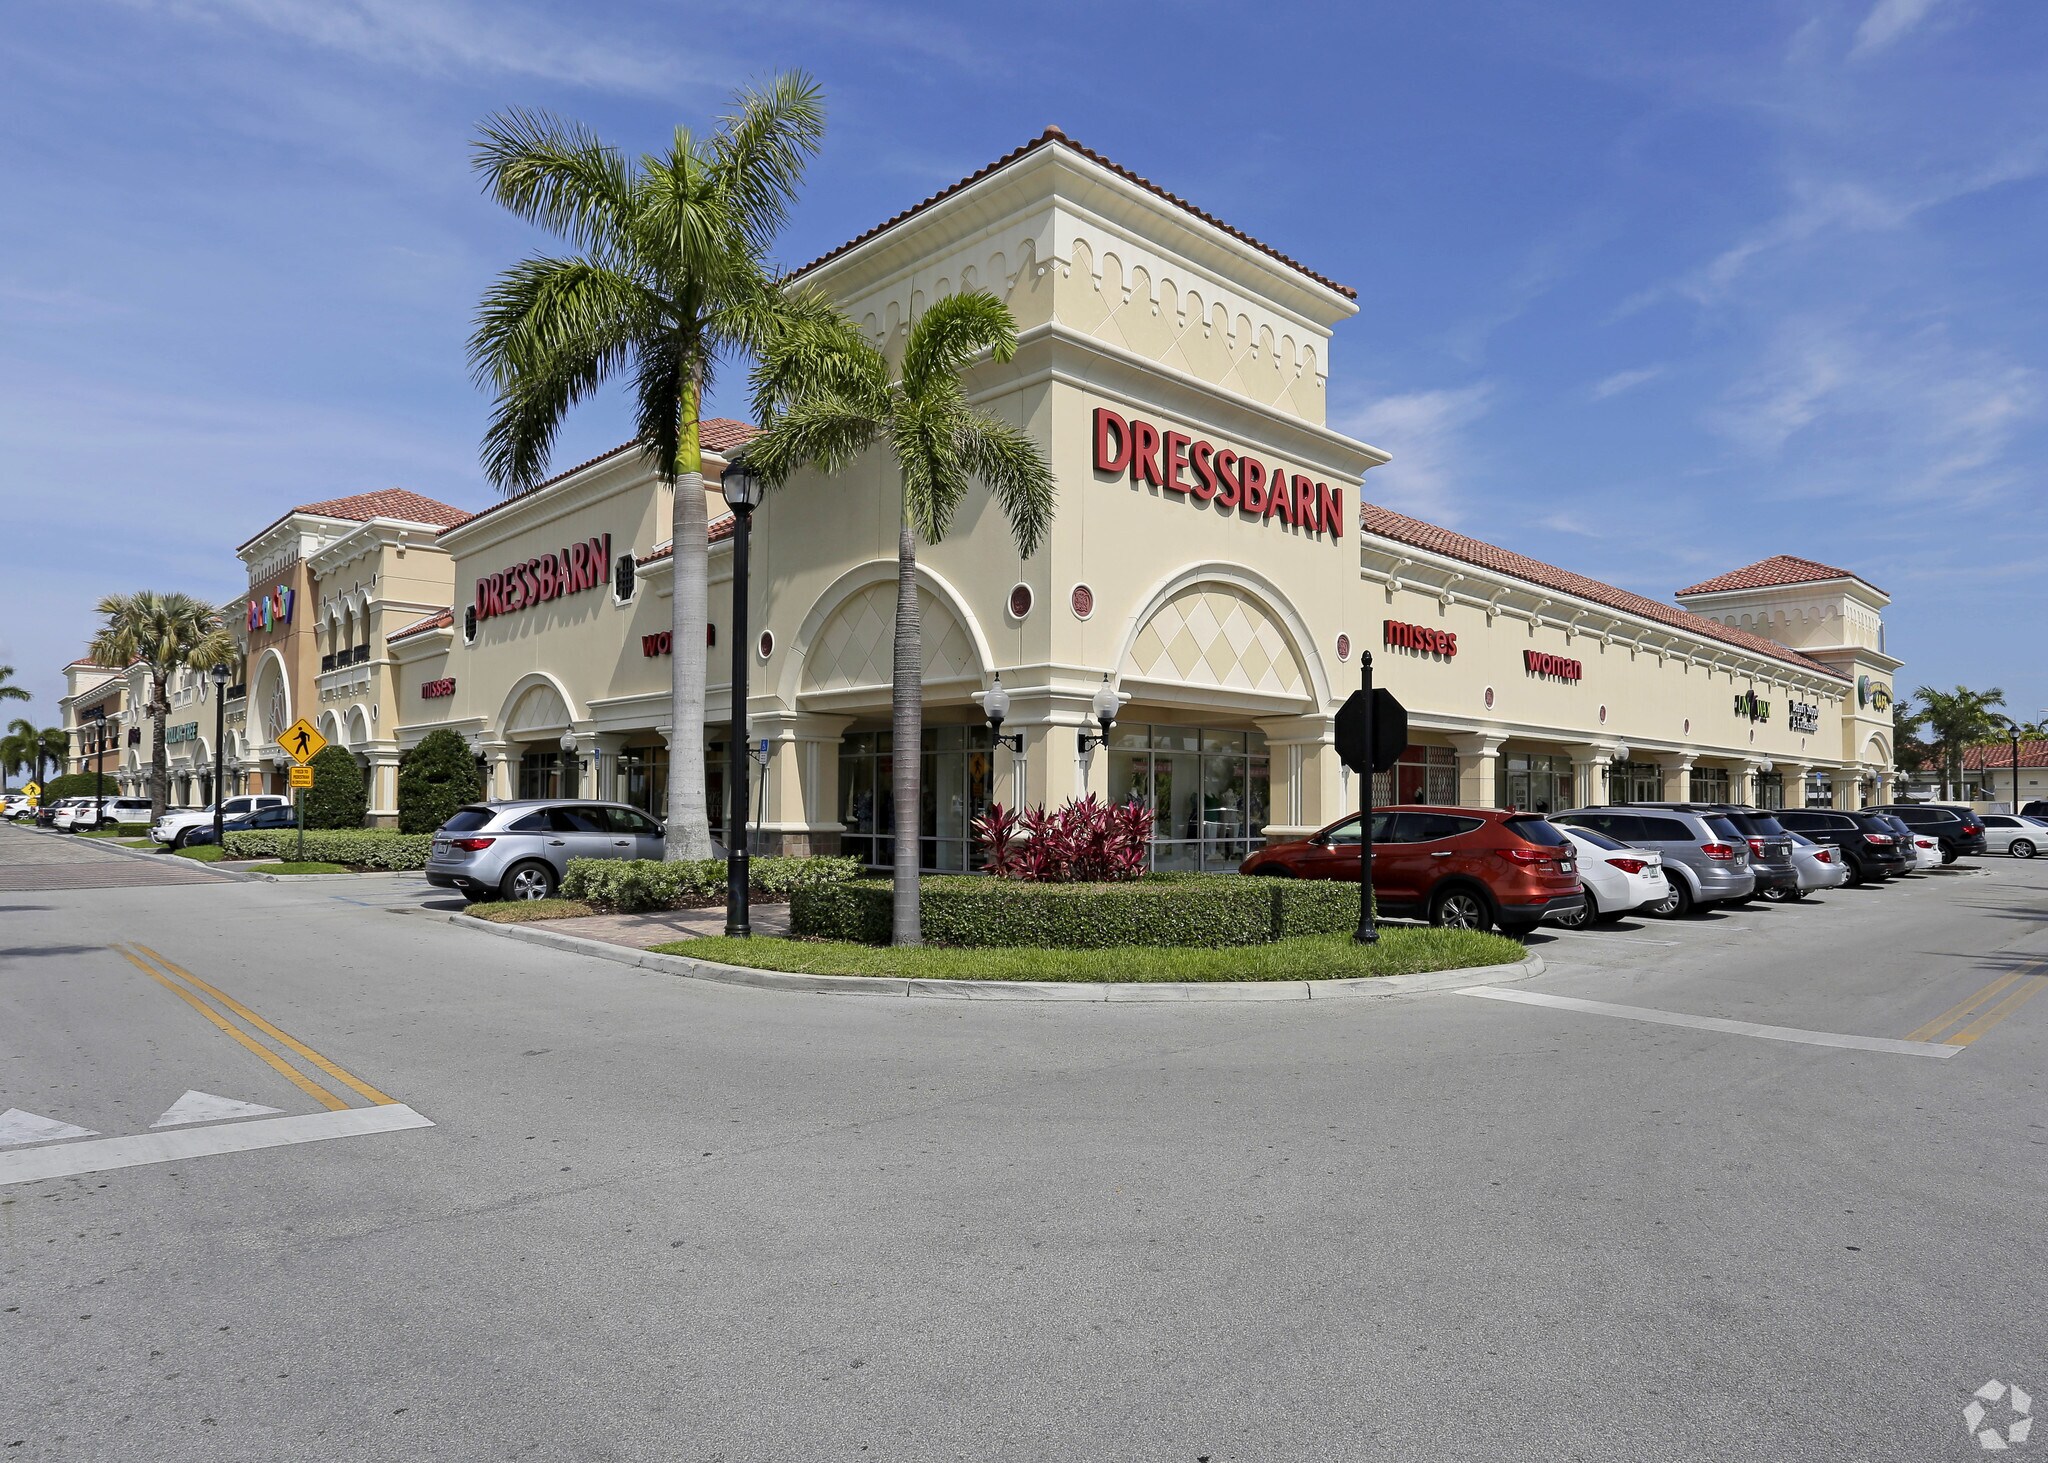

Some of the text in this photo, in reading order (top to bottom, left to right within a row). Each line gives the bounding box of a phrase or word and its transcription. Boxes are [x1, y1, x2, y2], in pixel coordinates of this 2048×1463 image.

[1093, 407, 1343, 538] DRESSBARN
[476, 533, 611, 621] DRESSBARN
[1383, 620, 1457, 656] misses
[1523, 650, 1582, 680] woman
[421, 677, 456, 699] misses
